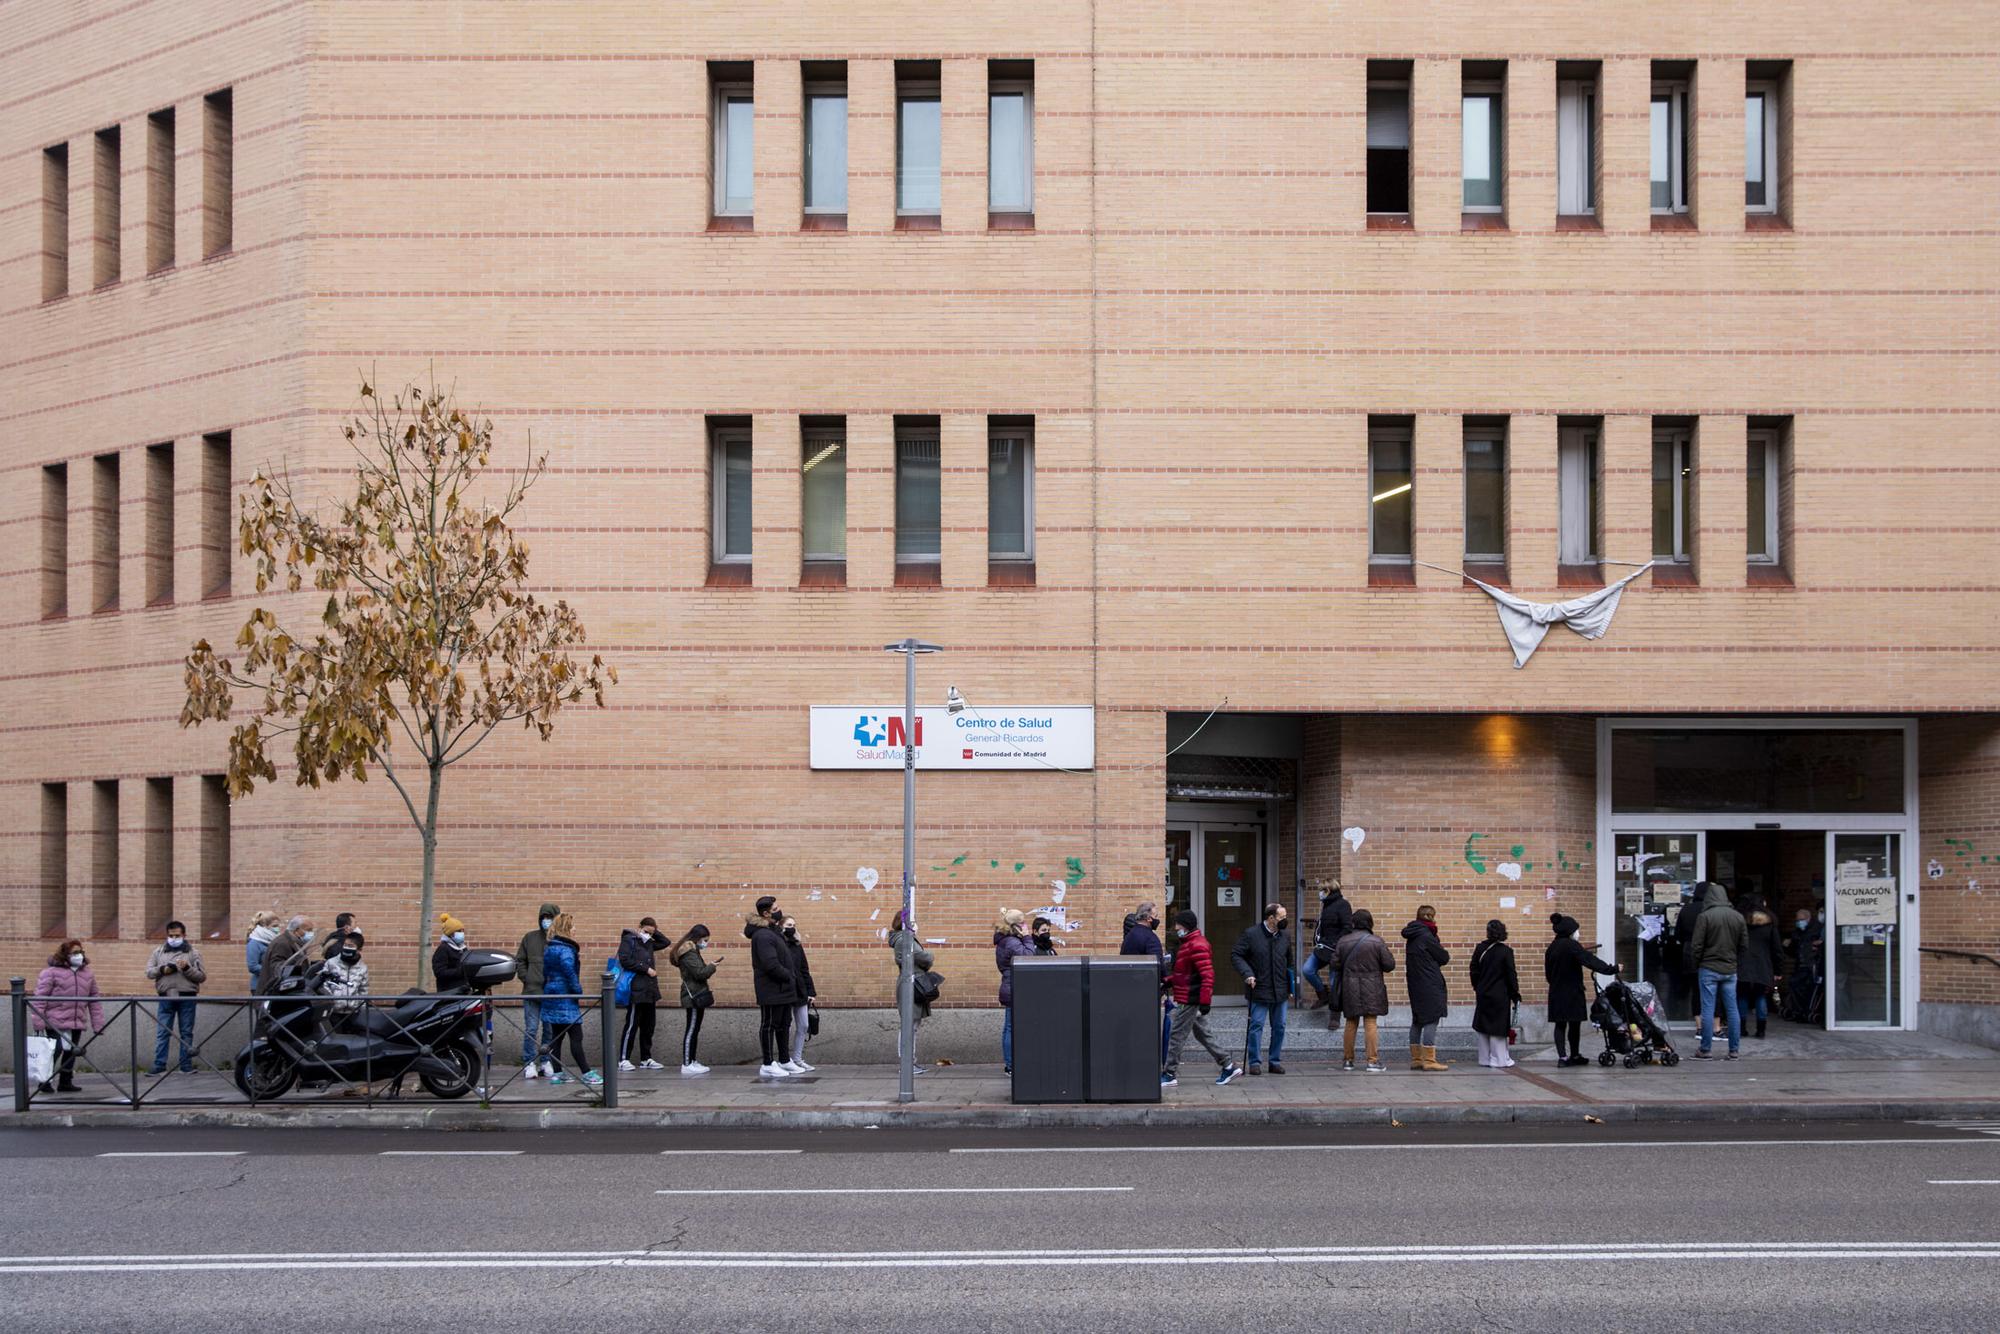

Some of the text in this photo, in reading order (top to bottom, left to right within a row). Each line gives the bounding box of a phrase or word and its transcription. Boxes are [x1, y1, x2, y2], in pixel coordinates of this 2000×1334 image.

[956, 717, 1053, 728] Centro de Salud
[965, 733, 1044, 743] General Ricardos
[1835, 887, 1890, 896] VACUNACIÓN
